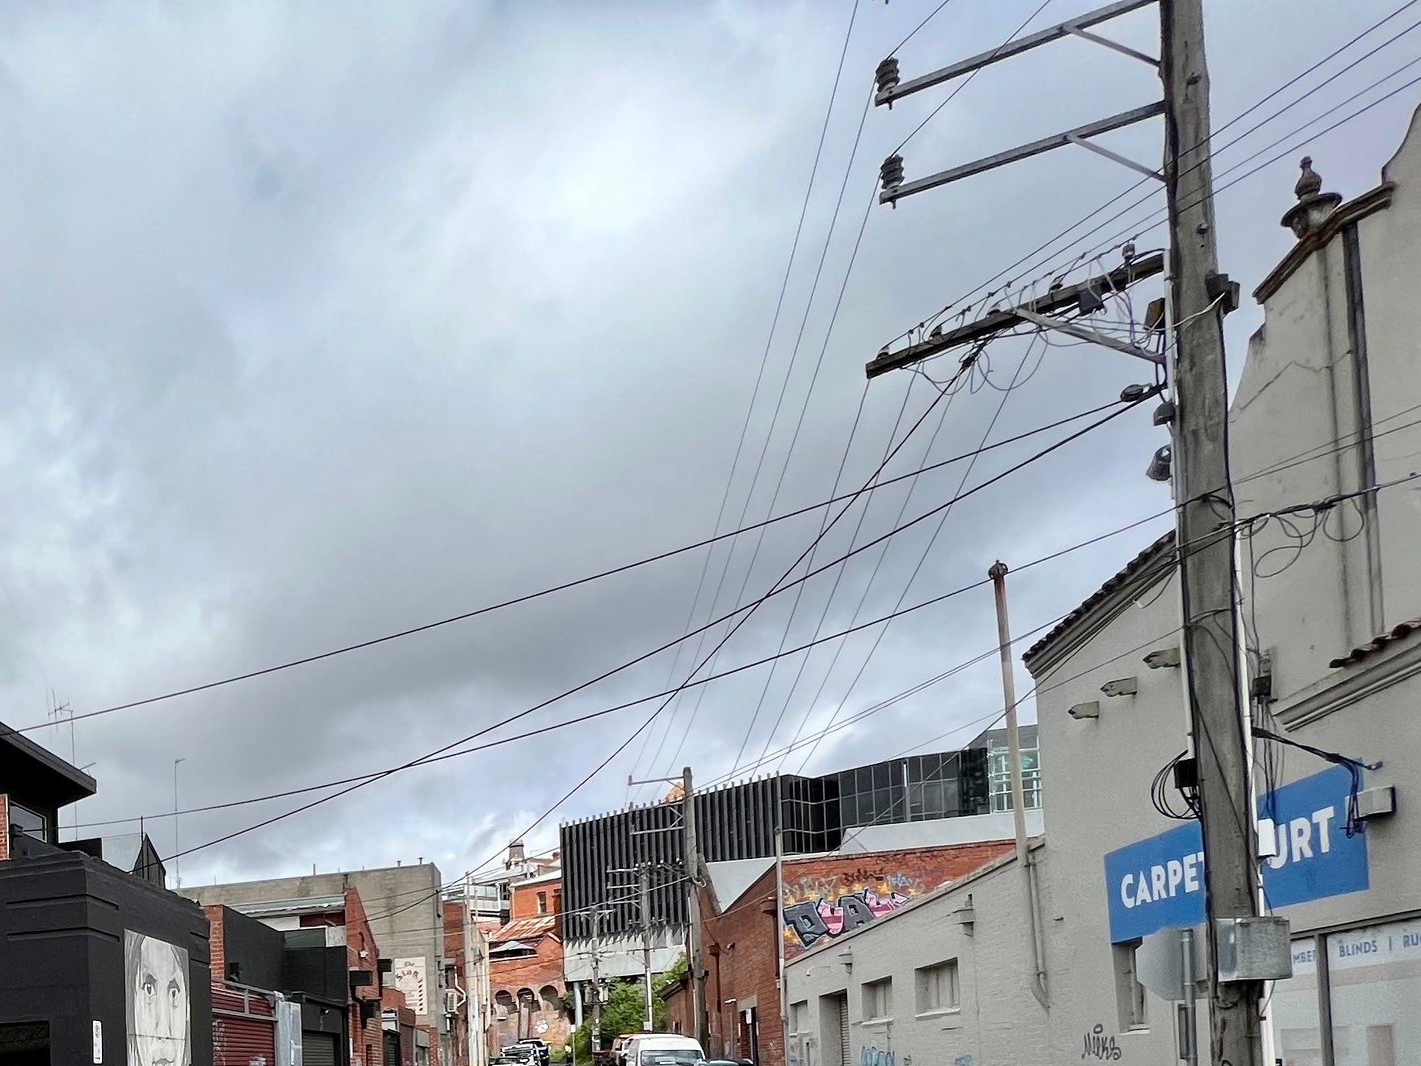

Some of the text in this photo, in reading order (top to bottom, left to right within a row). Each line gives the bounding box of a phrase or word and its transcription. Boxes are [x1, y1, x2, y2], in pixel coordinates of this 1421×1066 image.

[1267, 805, 1335, 869] URT
[1338, 939, 1378, 958] BLINDS
[1402, 933, 1421, 949] RU
